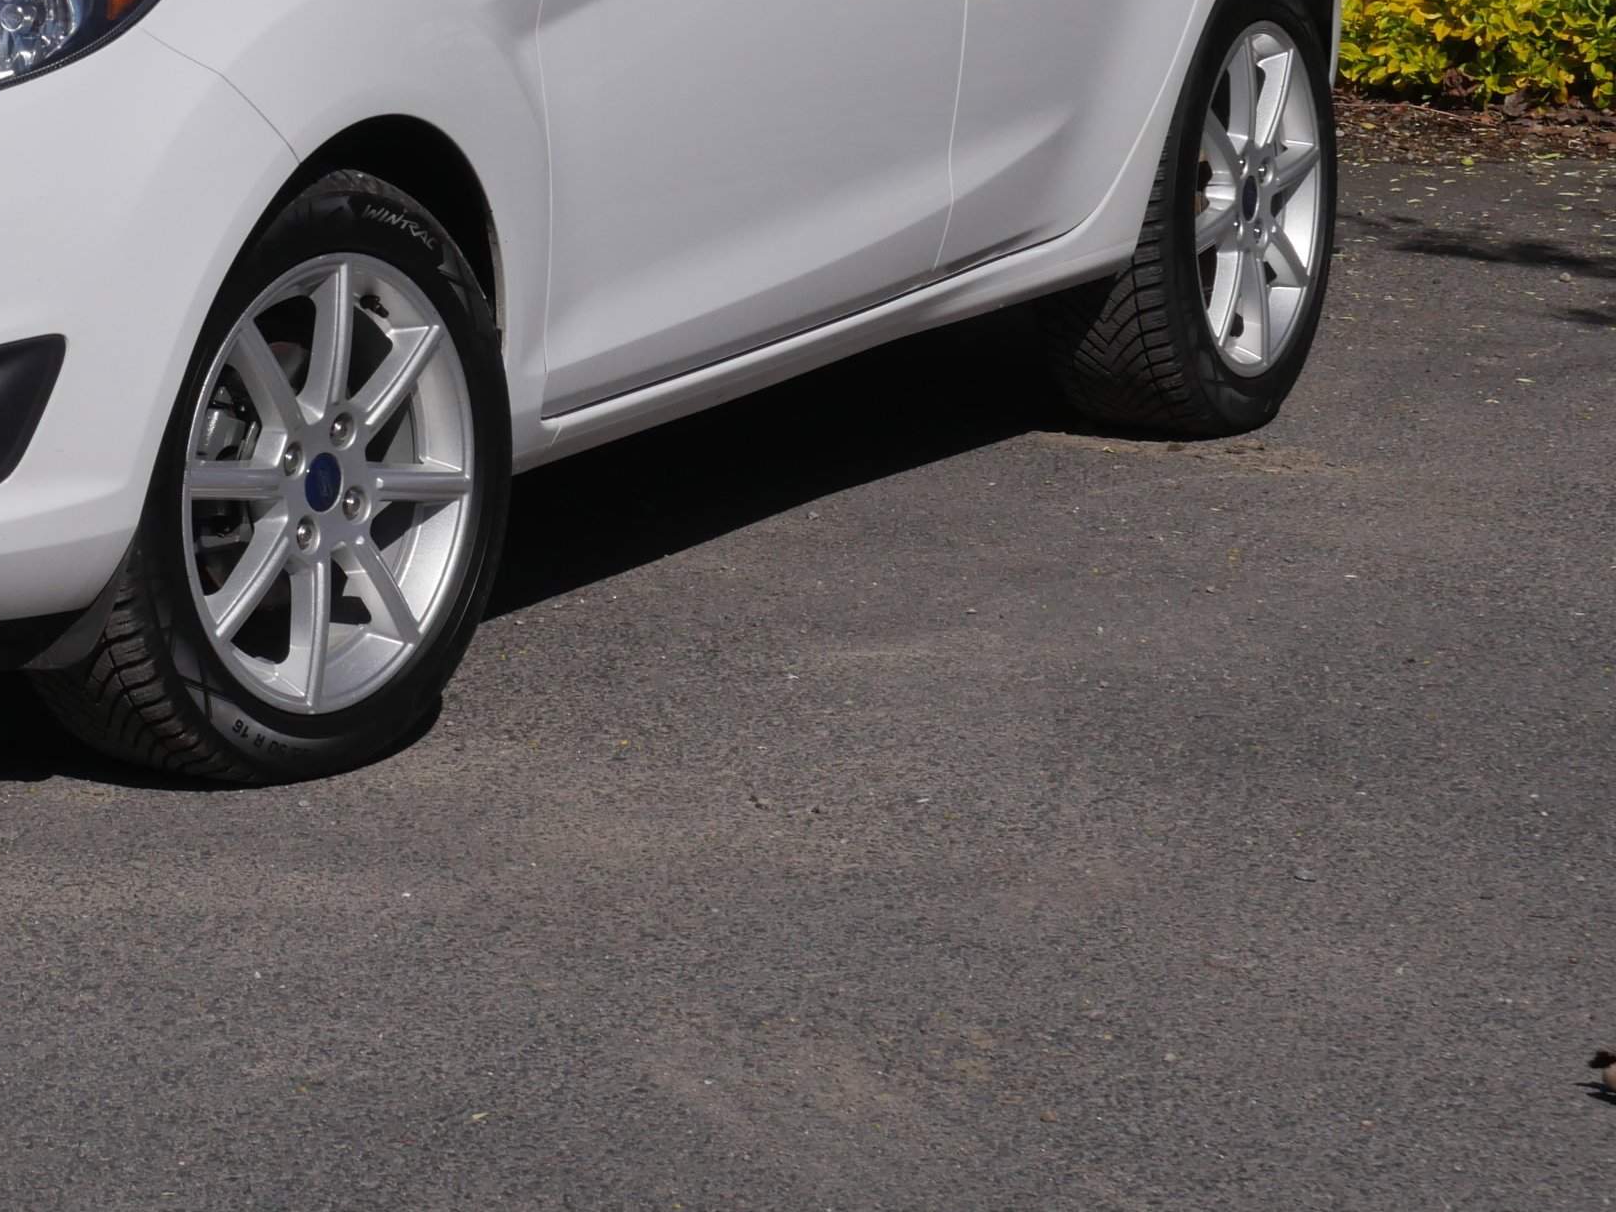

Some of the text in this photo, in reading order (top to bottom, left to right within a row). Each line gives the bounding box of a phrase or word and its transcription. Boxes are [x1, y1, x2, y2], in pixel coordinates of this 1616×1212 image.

[362, 204, 434, 250] WINTRAC
[232, 719, 249, 738] 16
[253, 733, 266, 748] R
